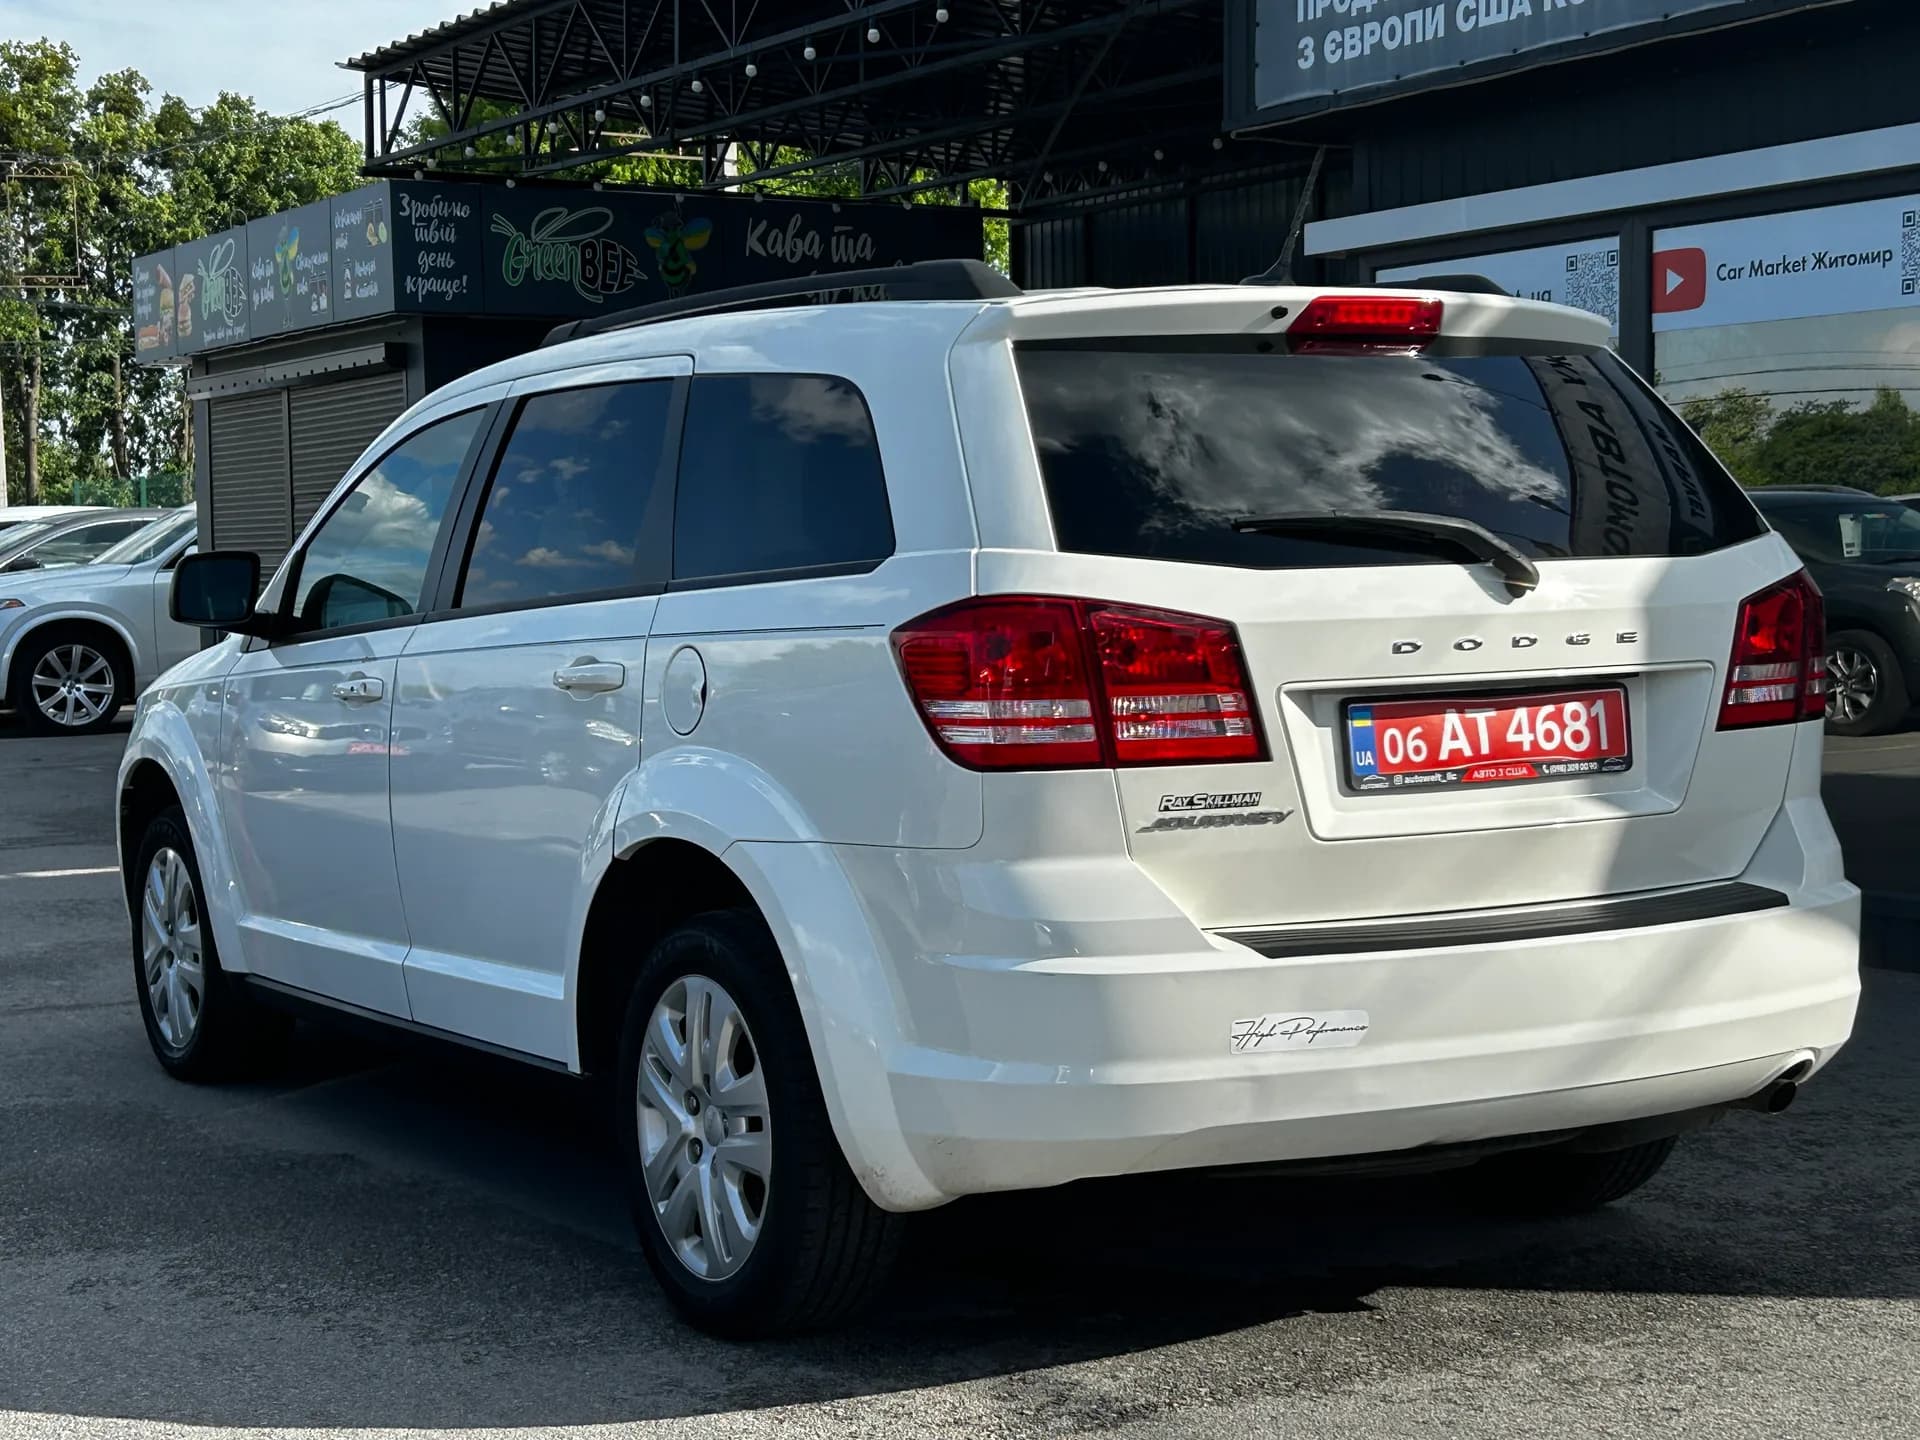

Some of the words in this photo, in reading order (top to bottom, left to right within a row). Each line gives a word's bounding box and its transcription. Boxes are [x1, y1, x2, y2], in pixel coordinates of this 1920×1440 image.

[1297, 36, 1315, 69] З
[1324, 4, 1445, 64] ЄВРОПИ
[1456, 0, 1532, 32] США
[400, 193, 471, 226] Зробимо
[414, 218, 457, 244] твій
[746, 213, 824, 264] Кава
[831, 225, 876, 263] та
[418, 251, 455, 274] день
[1716, 263, 1744, 282] Car
[1749, 254, 1807, 279] Market
[1811, 248, 1894, 271] Житомир
[404, 275, 468, 303] краще!
[1392, 631, 1638, 654] DODGE
[1383, 726, 1428, 765] 06
[1438, 707, 1497, 761] AT
[1506, 699, 1609, 752] 4681
[1356, 751, 1375, 766] UA
[1472, 769, 1496, 779] АВТО
[1505, 766, 1529, 776] США
